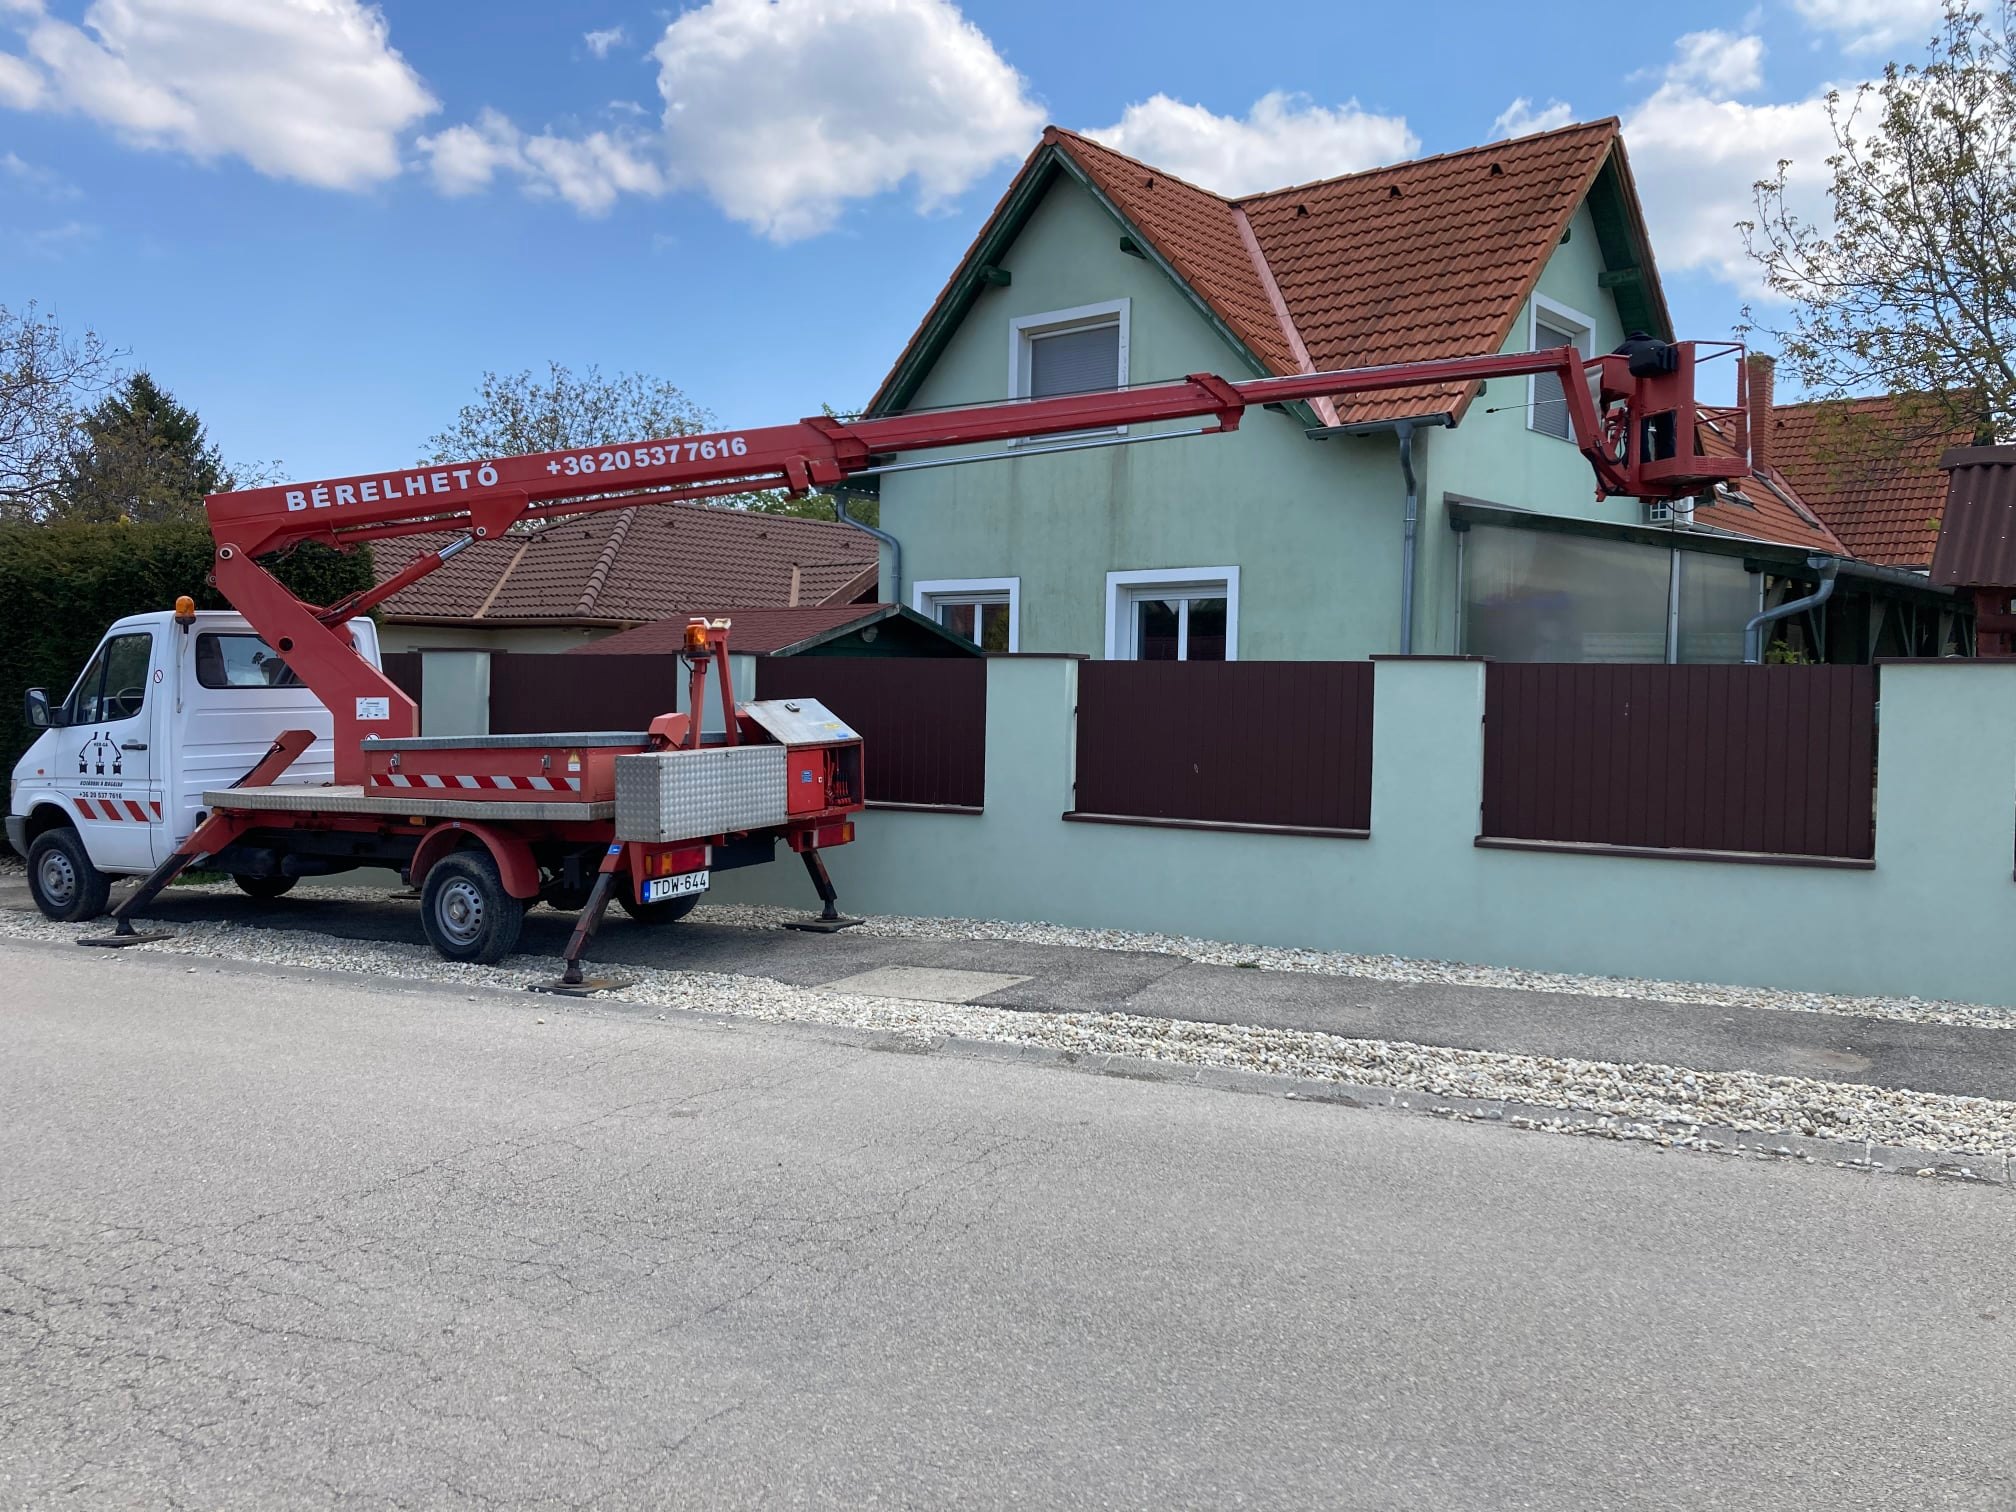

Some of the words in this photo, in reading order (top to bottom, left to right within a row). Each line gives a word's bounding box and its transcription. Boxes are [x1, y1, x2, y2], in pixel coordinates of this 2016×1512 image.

[546, 454, 596, 476] +36
[598, 450, 631, 472] 20
[634, 444, 680, 468] 537
[684, 436, 748, 461] 7616
[285, 462, 499, 512] BÉRELHETŐ
[653, 872, 706, 896] TDW-644
